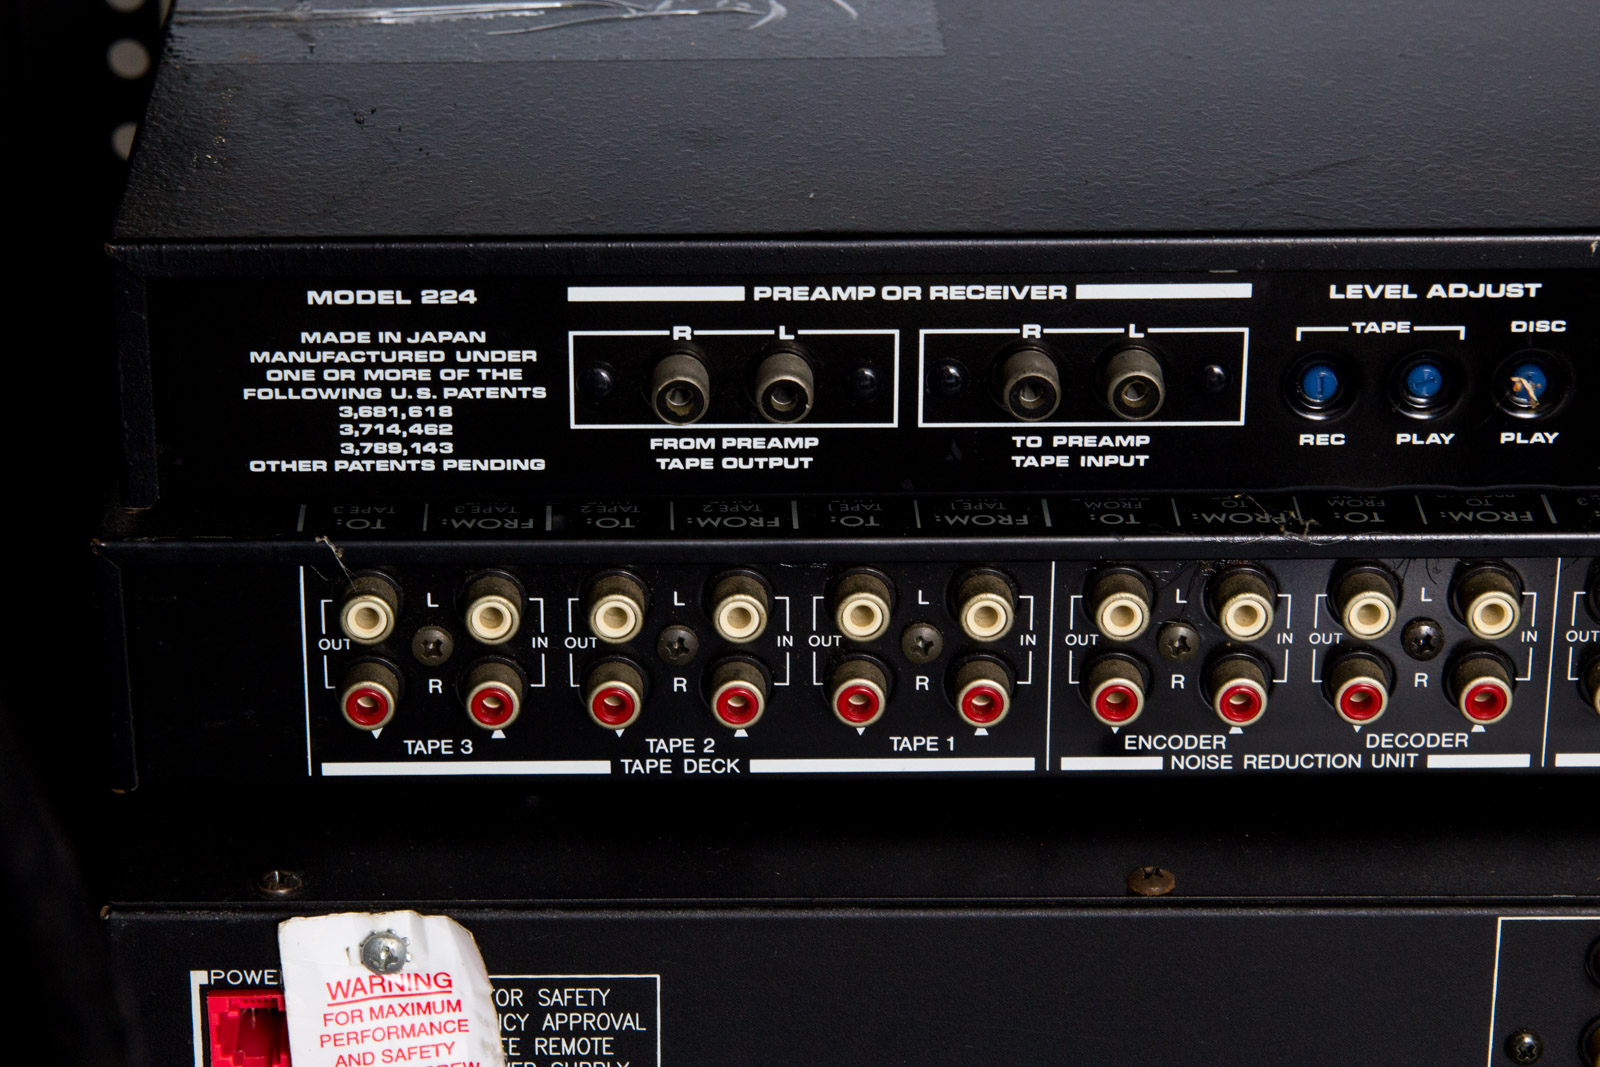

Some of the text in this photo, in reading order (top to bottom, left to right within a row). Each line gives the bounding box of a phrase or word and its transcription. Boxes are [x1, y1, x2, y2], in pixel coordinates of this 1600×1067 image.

[307, 290, 477, 305] MODEL 224
[754, 285, 1067, 301] PREAMP OR RECEIVER
[1330, 283, 1542, 299] LEVEL ADJUST
[672, 325, 692, 341] R
[779, 326, 794, 340] L
[1022, 324, 1042, 339] R
[1129, 324, 1144, 338] L
[1352, 321, 1411, 333] TAPE
[1511, 320, 1566, 332] DISC
[301, 331, 486, 343] MADE IN JAPAN
[250, 350, 537, 363] MANUFACTURED UNDER
[266, 369, 522, 381] ONE OR MORE OF THE
[244, 387, 546, 400] FOLLOWING U.S. PATENTS
[339, 406, 452, 420] 3,681,618
[340, 424, 453, 437] 3,714,462
[1501, 432, 1559, 443] PLAY
[650, 437, 819, 449] FROM PREAMP
[1012, 435, 1150, 447] TO PREAMP
[1299, 434, 1345, 445] REC
[1397, 433, 1455, 445] PLAY
[341, 442, 453, 456] 3,789,143
[250, 459, 545, 472] OTHER PATENTS PENDING
[656, 457, 813, 469] TAPE OUTPUT
[1011, 455, 1149, 467] TAPE INPUT
[427, 593, 439, 607] L
[674, 591, 685, 606] L
[918, 590, 929, 604] L
[1176, 589, 1187, 603] L
[1421, 587, 1432, 601] L
[532, 637, 548, 648] IN
[564, 636, 598, 649] OUT
[778, 636, 793, 647] IN
[807, 634, 843, 648] OUT
[1021, 634, 1036, 645] IN
[1065, 634, 1099, 645] OUT
[1277, 633, 1293, 644] IN
[1309, 632, 1343, 644] OUT
[1521, 631, 1537, 642] IN
[1566, 630, 1600, 642] OUT
[318, 638, 350, 651] OUT
[429, 679, 442, 693] R
[674, 678, 687, 692] R
[916, 676, 929, 690] R
[1172, 674, 1185, 689] R
[1415, 673, 1428, 687] R
[403, 739, 473, 754] TAPE 3
[646, 738, 715, 753] TAPE 2
[890, 736, 953, 751] TAPE 1
[1125, 735, 1226, 750] ENCODER
[1366, 733, 1470, 749] DECODER
[621, 759, 740, 774] TAPE DECK
[1172, 753, 1419, 769] NOISE REDUCTION UNIT
[210, 969, 282, 986] POWE
[326, 972, 453, 1001] WARNING
[491, 988, 610, 1008] OR SAFETY
[323, 999, 462, 1028] FOR MAXIMUM
[499, 1013, 646, 1032] CY APPROVAL
[320, 1018, 470, 1048] PERFORMANCE
[535, 1037, 614, 1055] REMOTE
[335, 1041, 456, 1067] AND SAFETY
